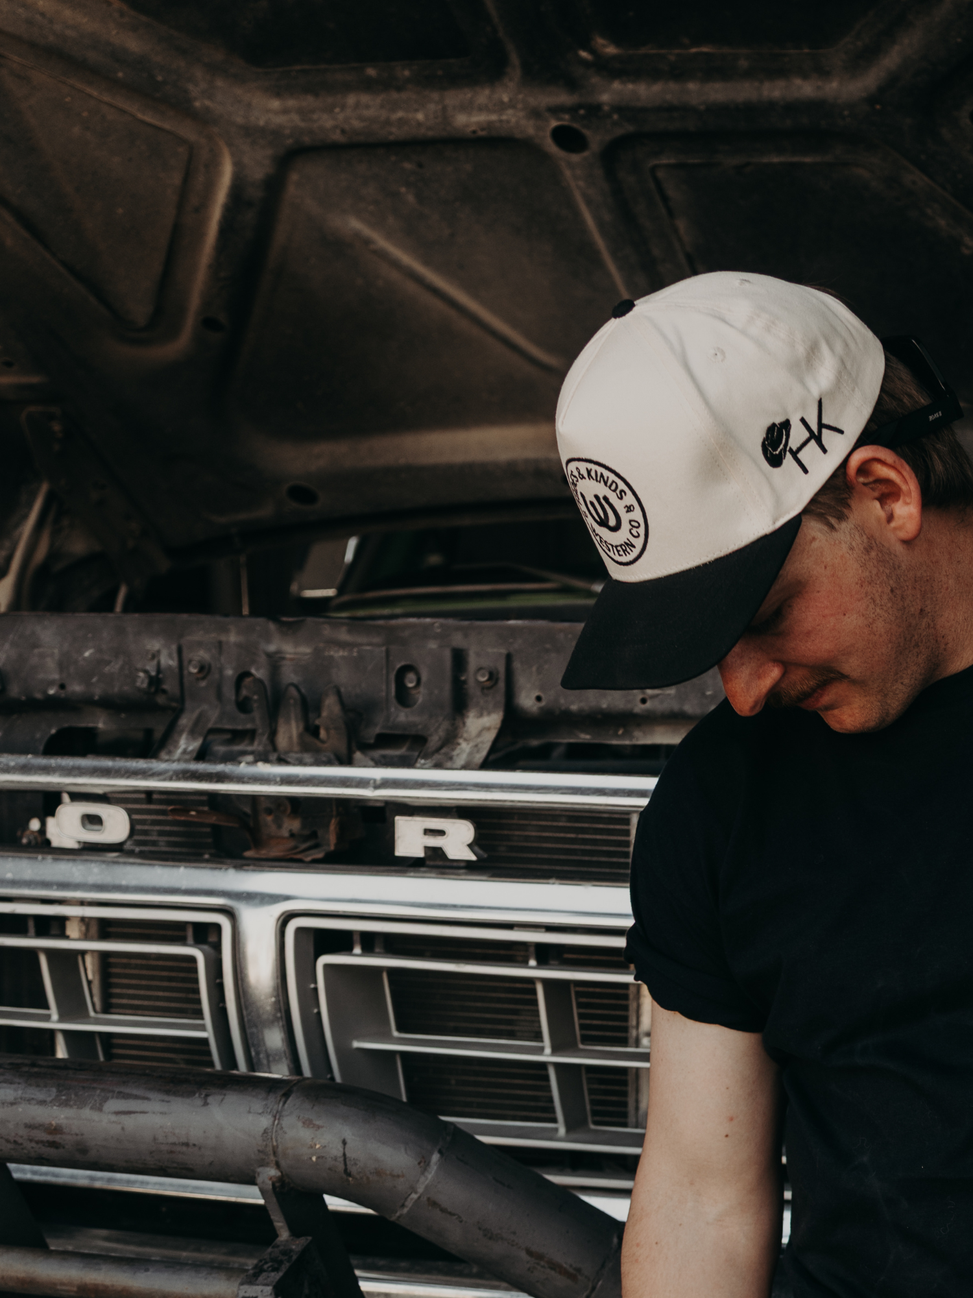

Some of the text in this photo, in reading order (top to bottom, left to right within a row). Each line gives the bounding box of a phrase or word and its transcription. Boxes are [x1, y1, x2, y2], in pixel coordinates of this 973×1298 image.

[788, 397, 844, 475] HK
[585, 467, 627, 501] KINDS
[629, 519, 641, 539] CO
